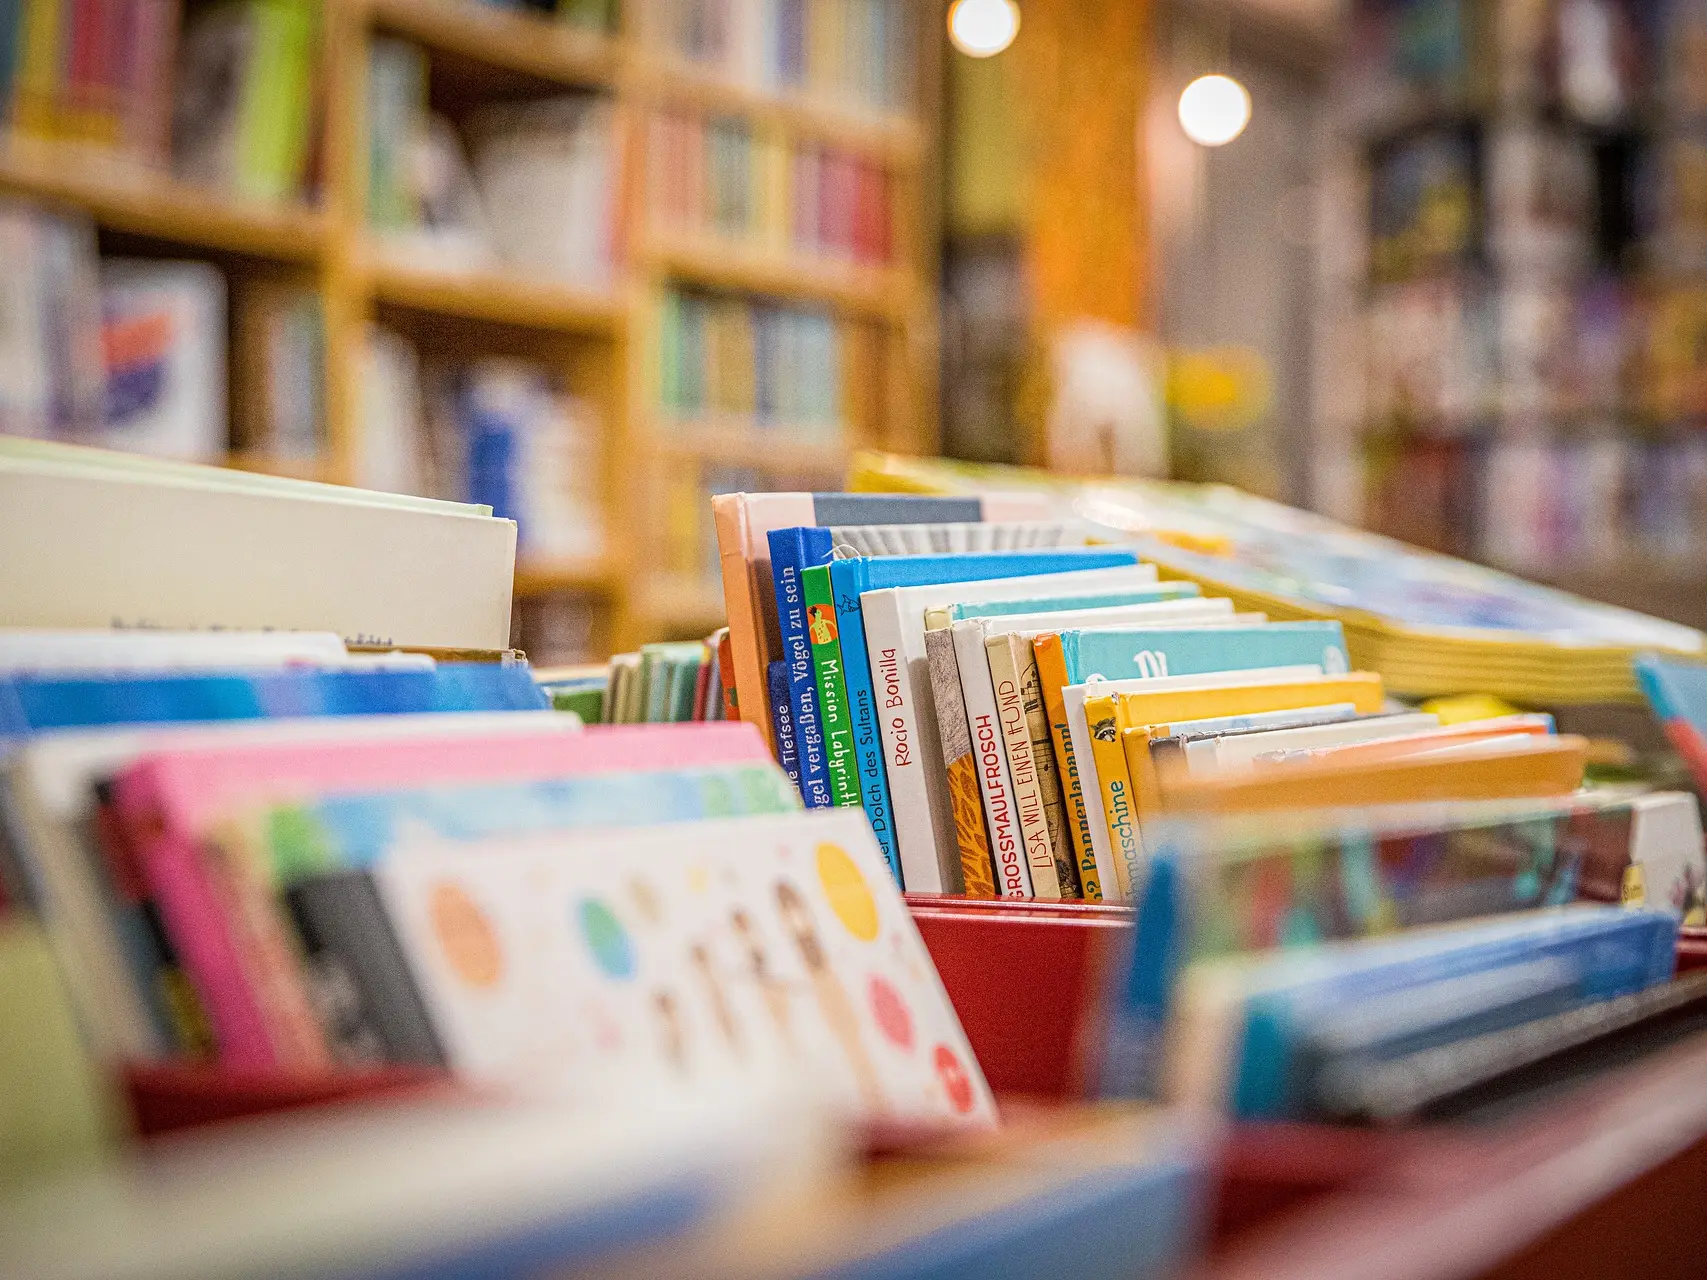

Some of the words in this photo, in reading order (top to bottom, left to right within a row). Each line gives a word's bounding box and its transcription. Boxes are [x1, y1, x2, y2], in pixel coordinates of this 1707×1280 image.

[780, 565, 798, 603] sein
[788, 607, 802, 629] zu
[787, 634, 811, 683] Vögel
[878, 647, 903, 709] Bonilla
[820, 659, 839, 723] Mission
[998, 679, 1023, 736] HUND
[778, 704, 795, 764] Tiefsee
[798, 686, 821, 772] vergaßen,
[855, 689, 873, 745] Sultans
[890, 717, 912, 767] Rocio
[828, 730, 858, 809] Labyrinth
[863, 751, 879, 778] des
[1009, 740, 1034, 785] EINEN
[867, 783, 887, 832] Dolch
[975, 714, 1025, 899] GROSSMAULFROSCH
[1019, 789, 1041, 827] WILL
[1027, 829, 1054, 869] LISA
